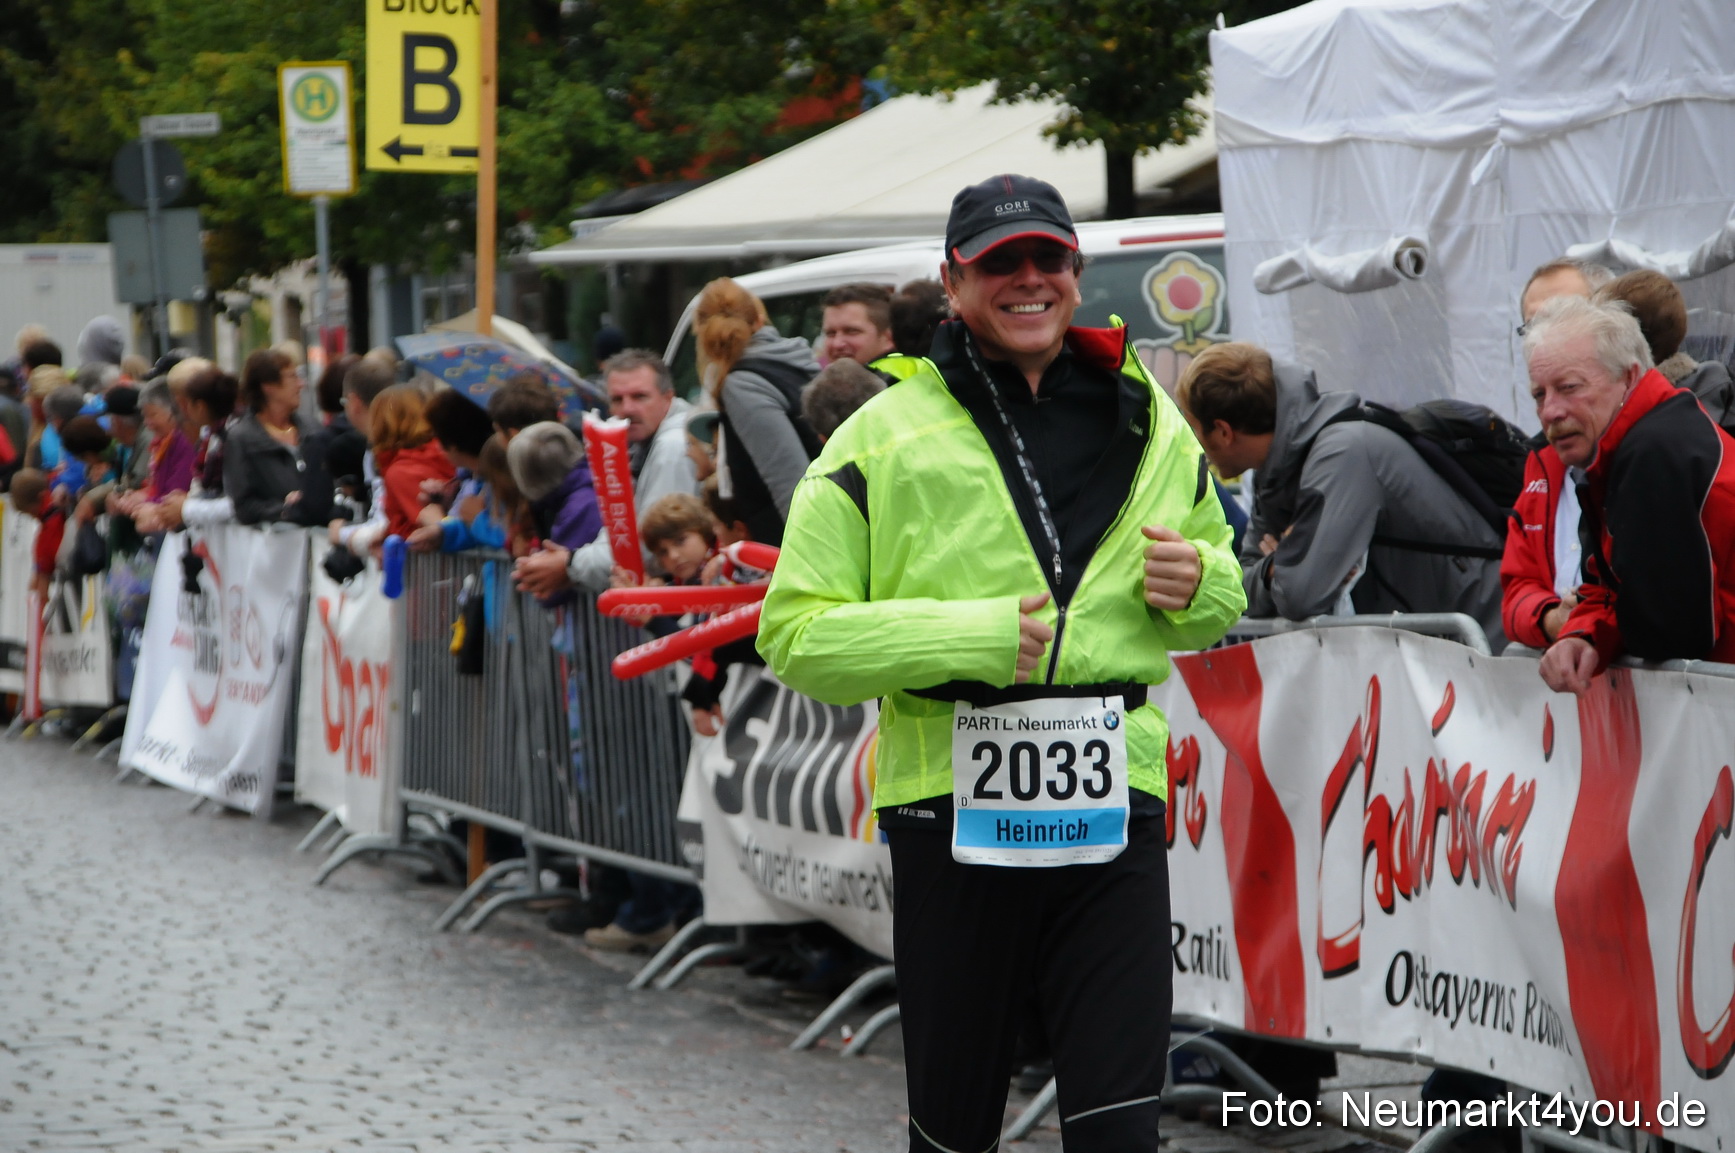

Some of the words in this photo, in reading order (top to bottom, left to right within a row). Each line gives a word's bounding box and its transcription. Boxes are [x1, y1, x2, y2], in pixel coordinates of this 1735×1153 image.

[402, 33, 461, 125] B
[995, 200, 1030, 213] GORE
[601, 441, 624, 496] Audi
[609, 502, 632, 548] BKK
[957, 716, 1013, 731] PARTL
[1018, 715, 1098, 731] Neumarkt
[972, 739, 1112, 801] 2033
[996, 818, 1089, 842] Heinrich
[1385, 950, 1516, 1034] Ostayerns
